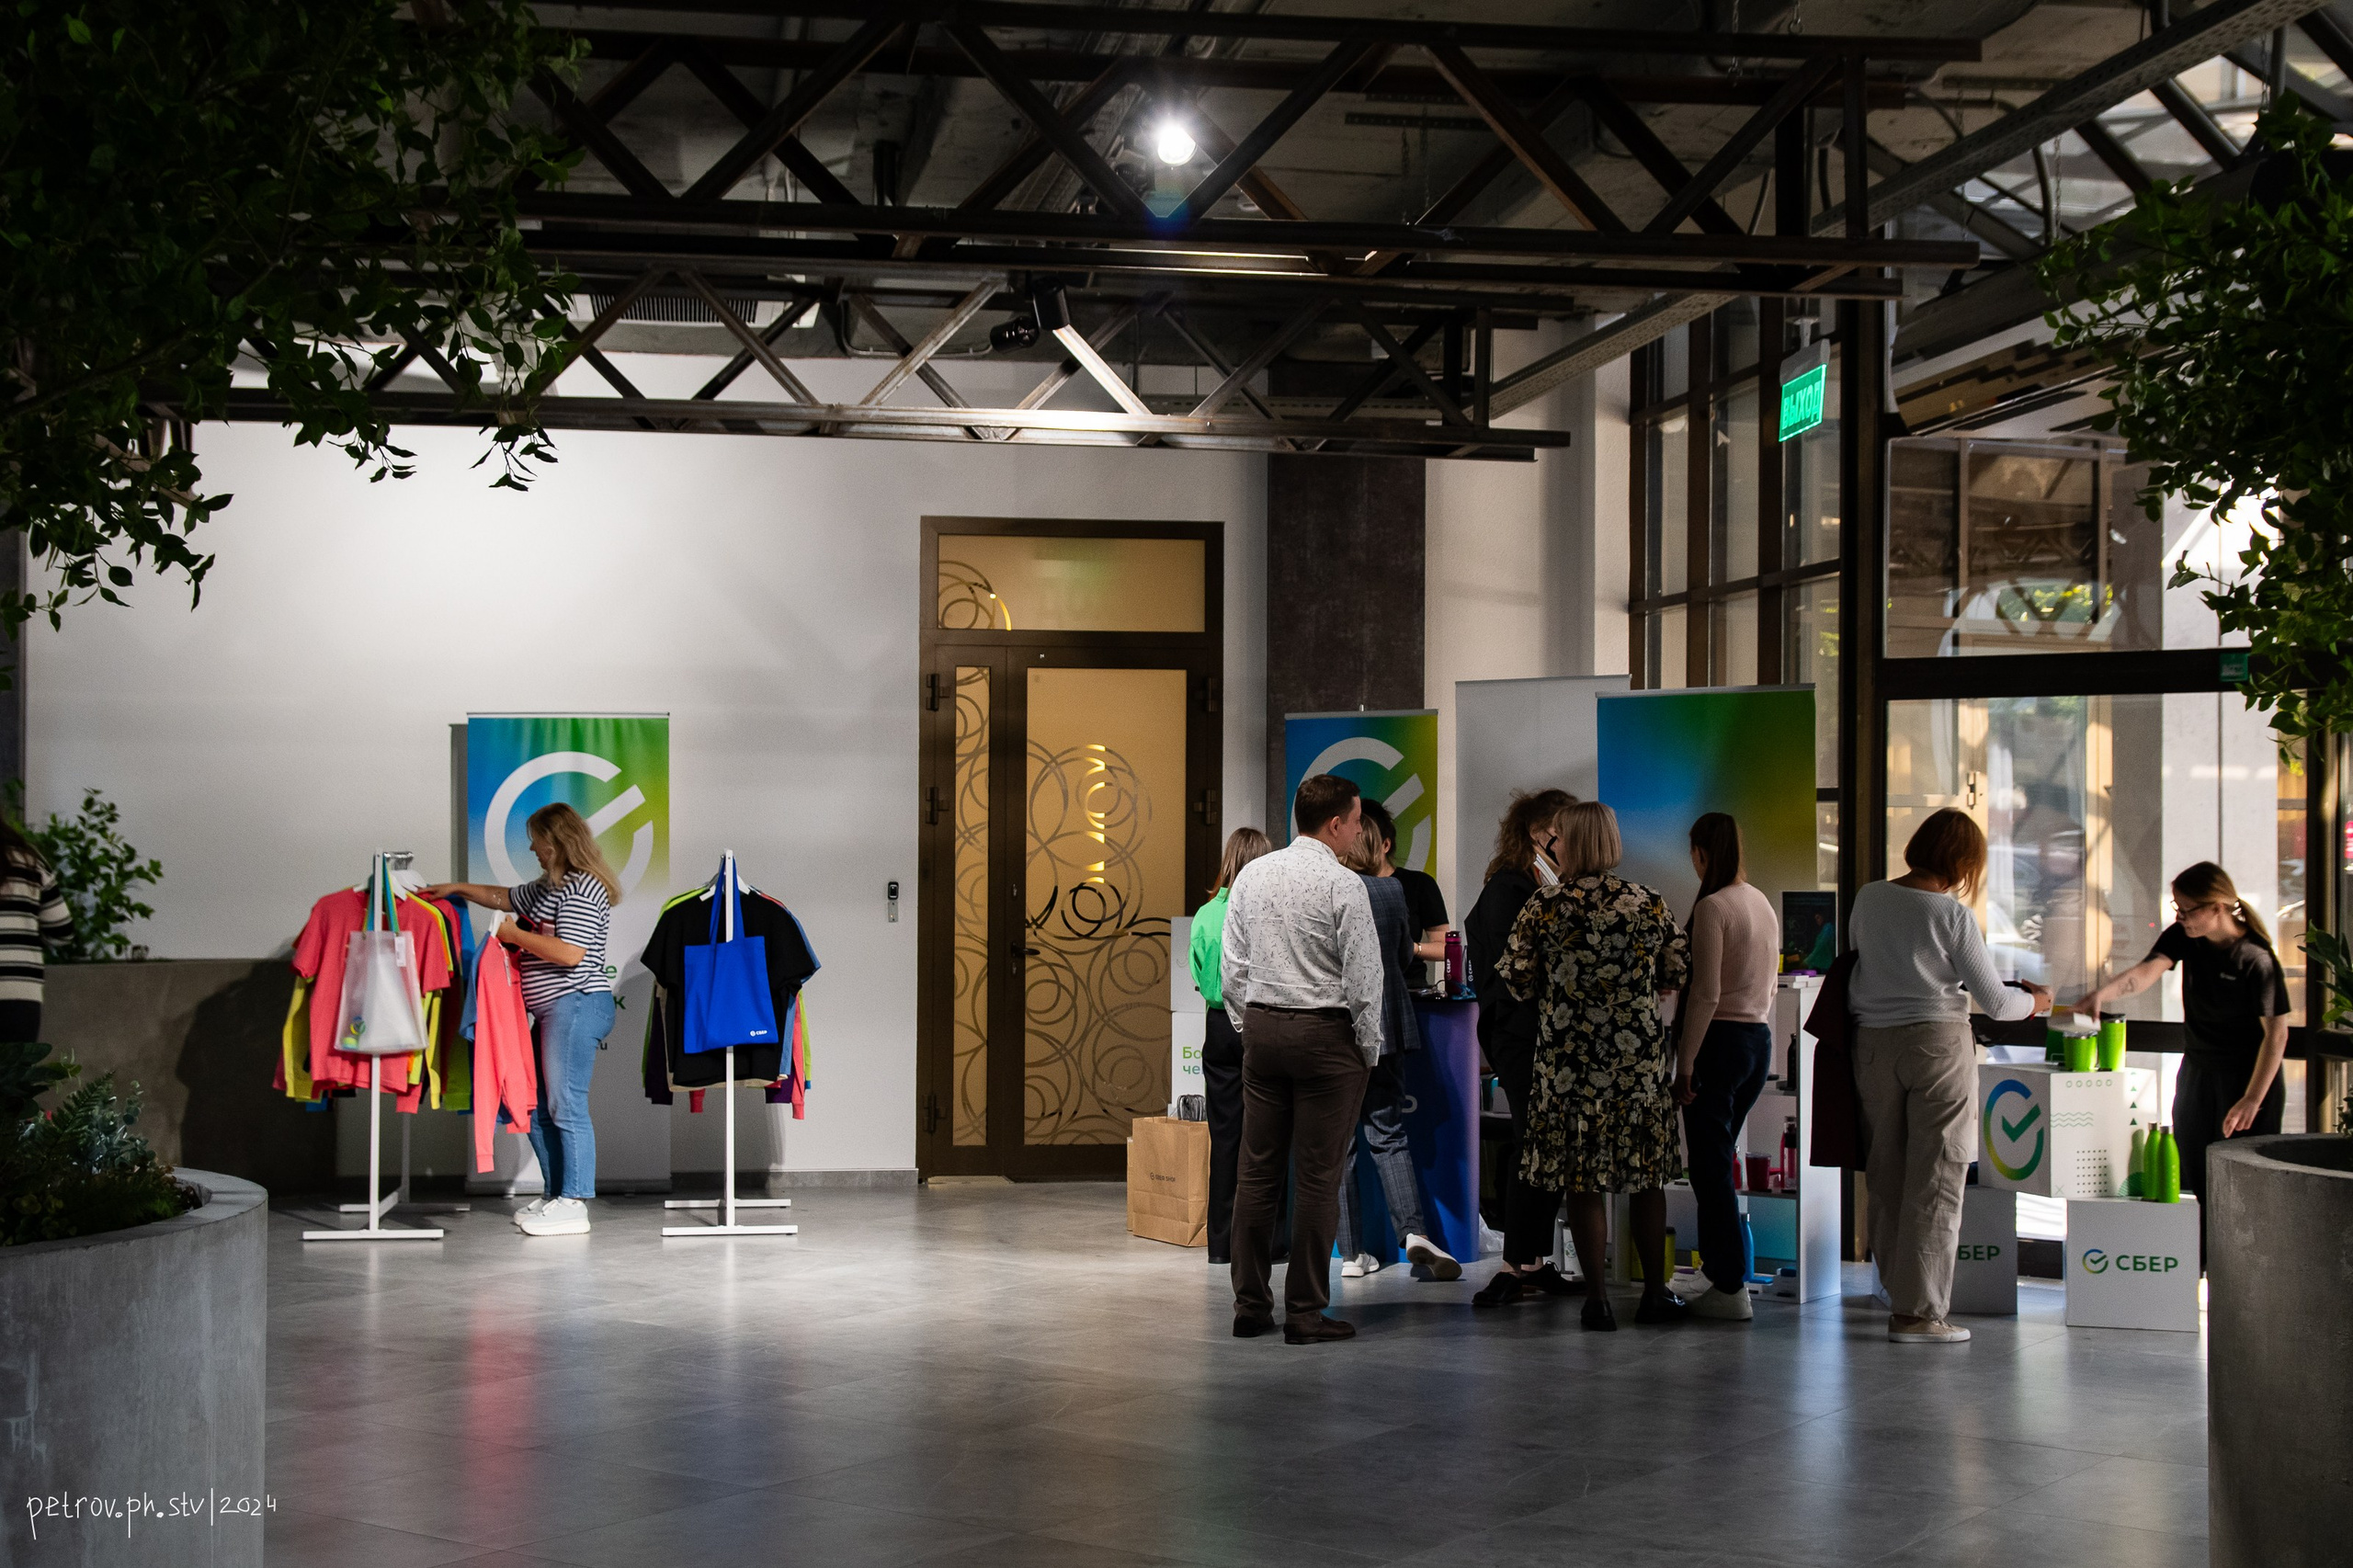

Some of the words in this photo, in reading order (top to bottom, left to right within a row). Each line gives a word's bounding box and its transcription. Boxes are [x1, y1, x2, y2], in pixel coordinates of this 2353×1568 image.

[1781, 380, 1822, 430] ВЫХОД
[1182, 1065, 1203, 1074] че
[1957, 1244, 2001, 1261] БЕР
[2116, 1254, 2179, 1273] СБЕР
